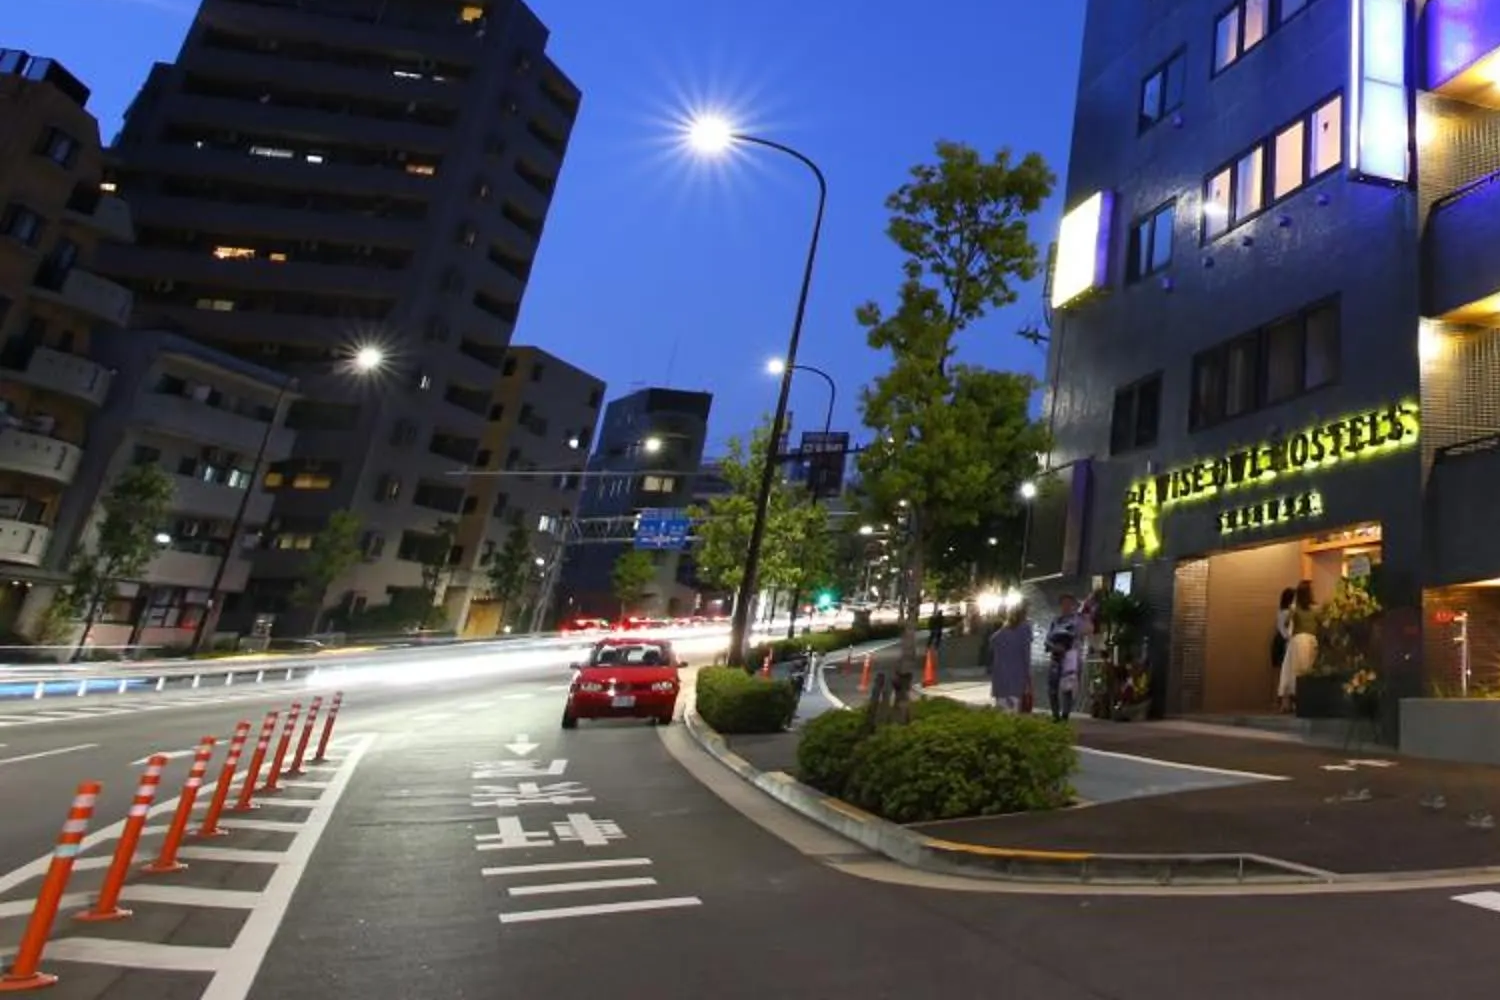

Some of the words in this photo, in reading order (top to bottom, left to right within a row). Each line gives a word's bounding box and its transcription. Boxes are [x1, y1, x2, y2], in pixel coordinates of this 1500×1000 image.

[1154, 463, 1210, 504] WISE
[1212, 448, 1265, 488] OWL
[1268, 402, 1420, 472] HOSTELS
